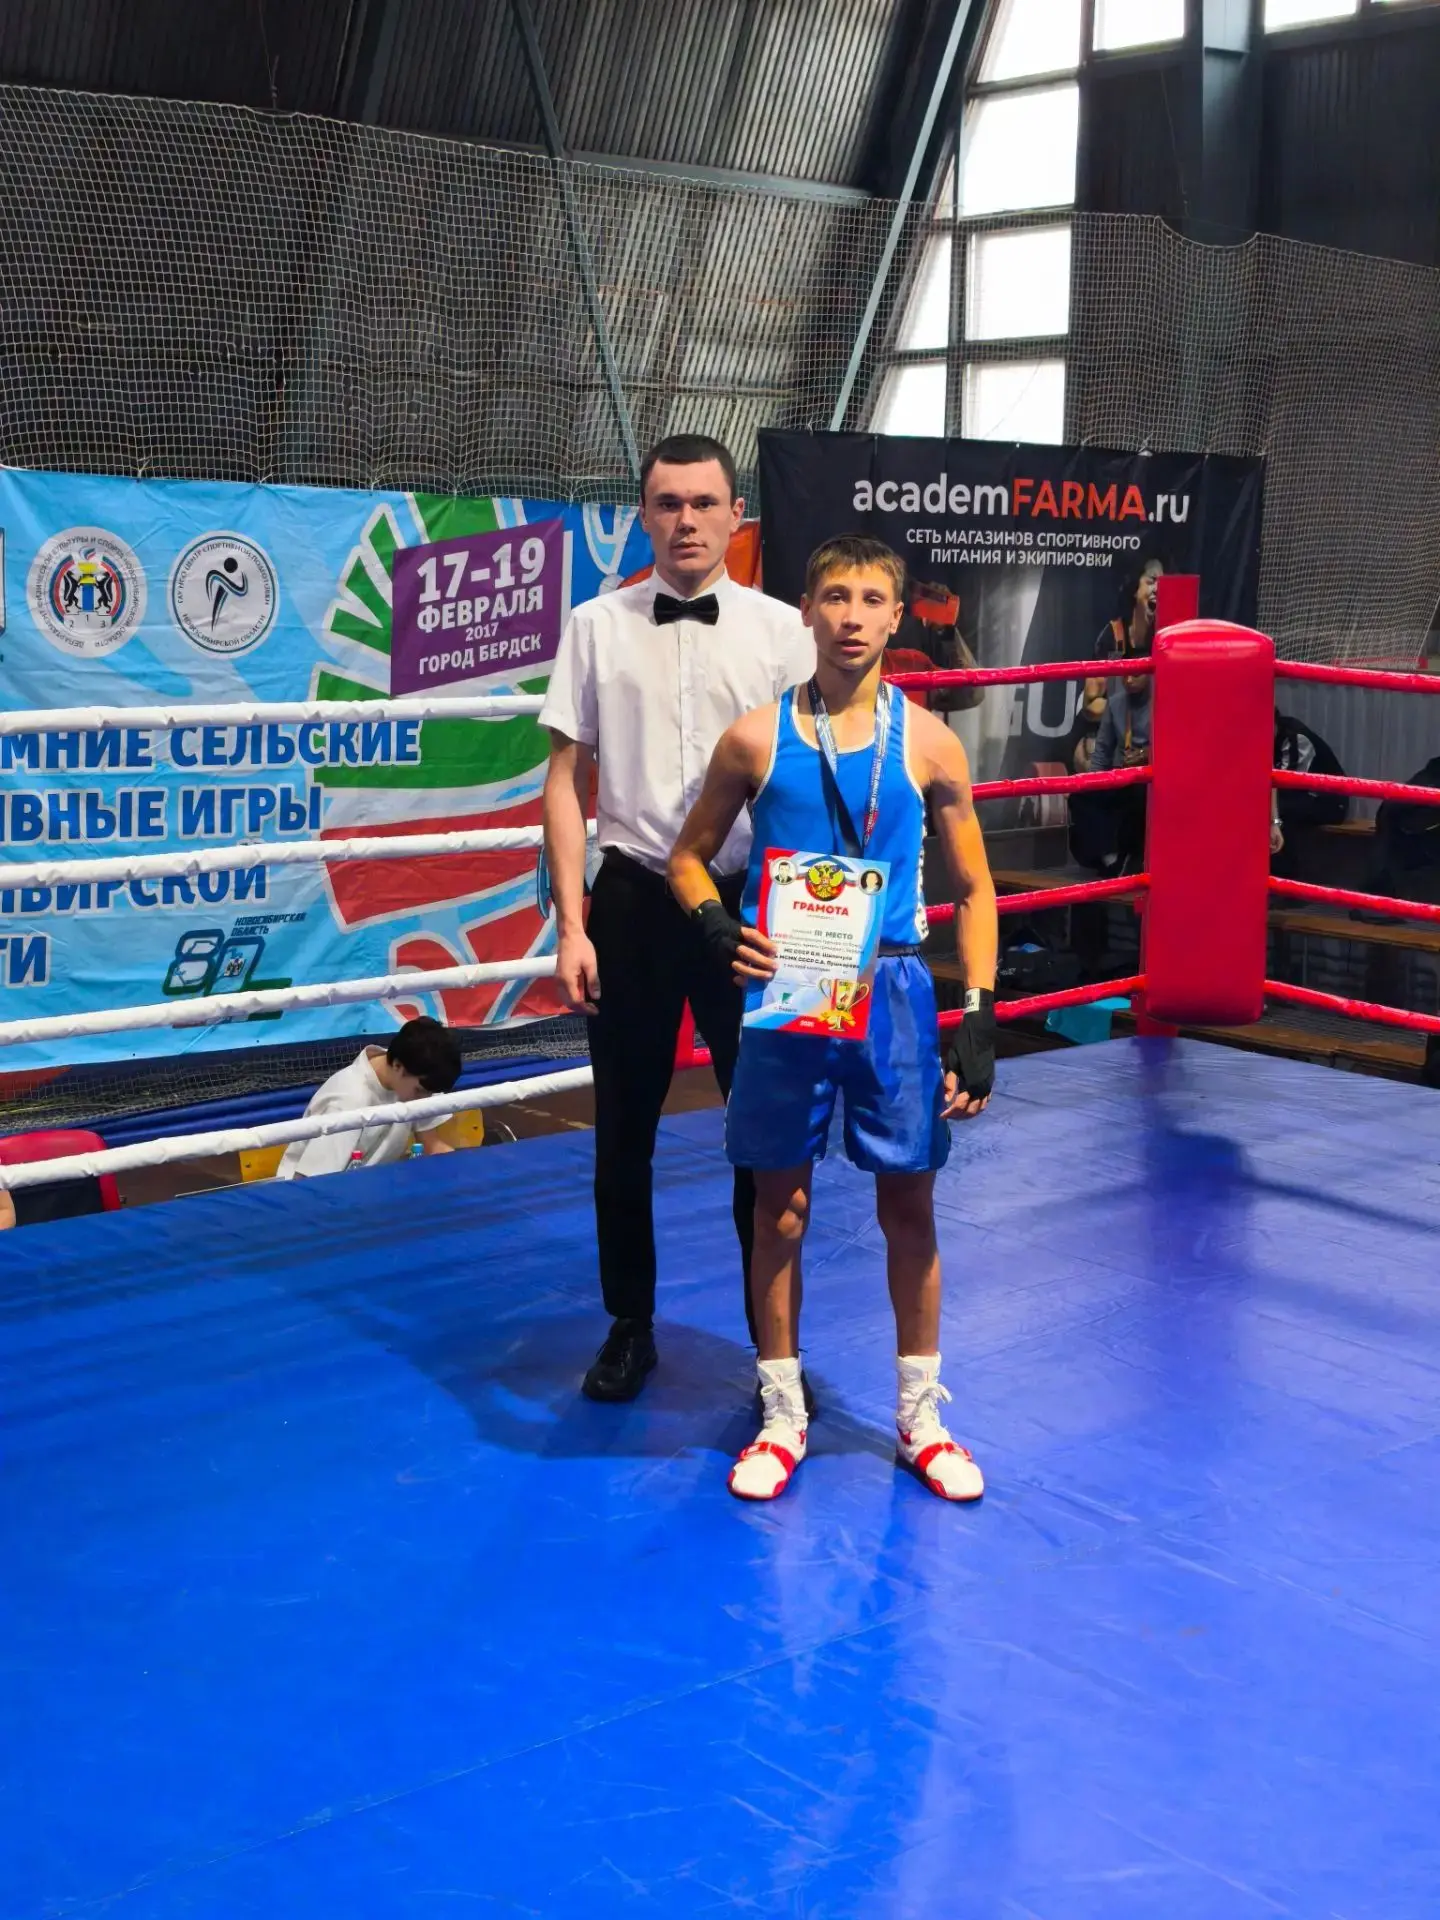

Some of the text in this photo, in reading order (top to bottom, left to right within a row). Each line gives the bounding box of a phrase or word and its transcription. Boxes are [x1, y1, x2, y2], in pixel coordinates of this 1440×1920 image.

[852, 472, 1190, 523] academFARMA.ru
[906, 529, 1141, 550] СЕТЬ МАГАЗИНОВ СПОРТИВНОГО
[931, 548, 1113, 568] ПИТАНИЯ И ЭКИПИРОВКИ
[416, 537, 546, 604] 17-19
[416, 585, 544, 633] ФЕВРАЛЯ
[465, 622, 500, 642] 2017
[419, 633, 542, 675] ГОРОД БЕРДСК
[170, 720, 422, 767] СЕЛЬСКИЕ
[0, 786, 322, 842] ВНЫЕ ИГРЫ
[793, 901, 849, 916] ГРАМОТА
[825, 931, 854, 940] МЕСТО
